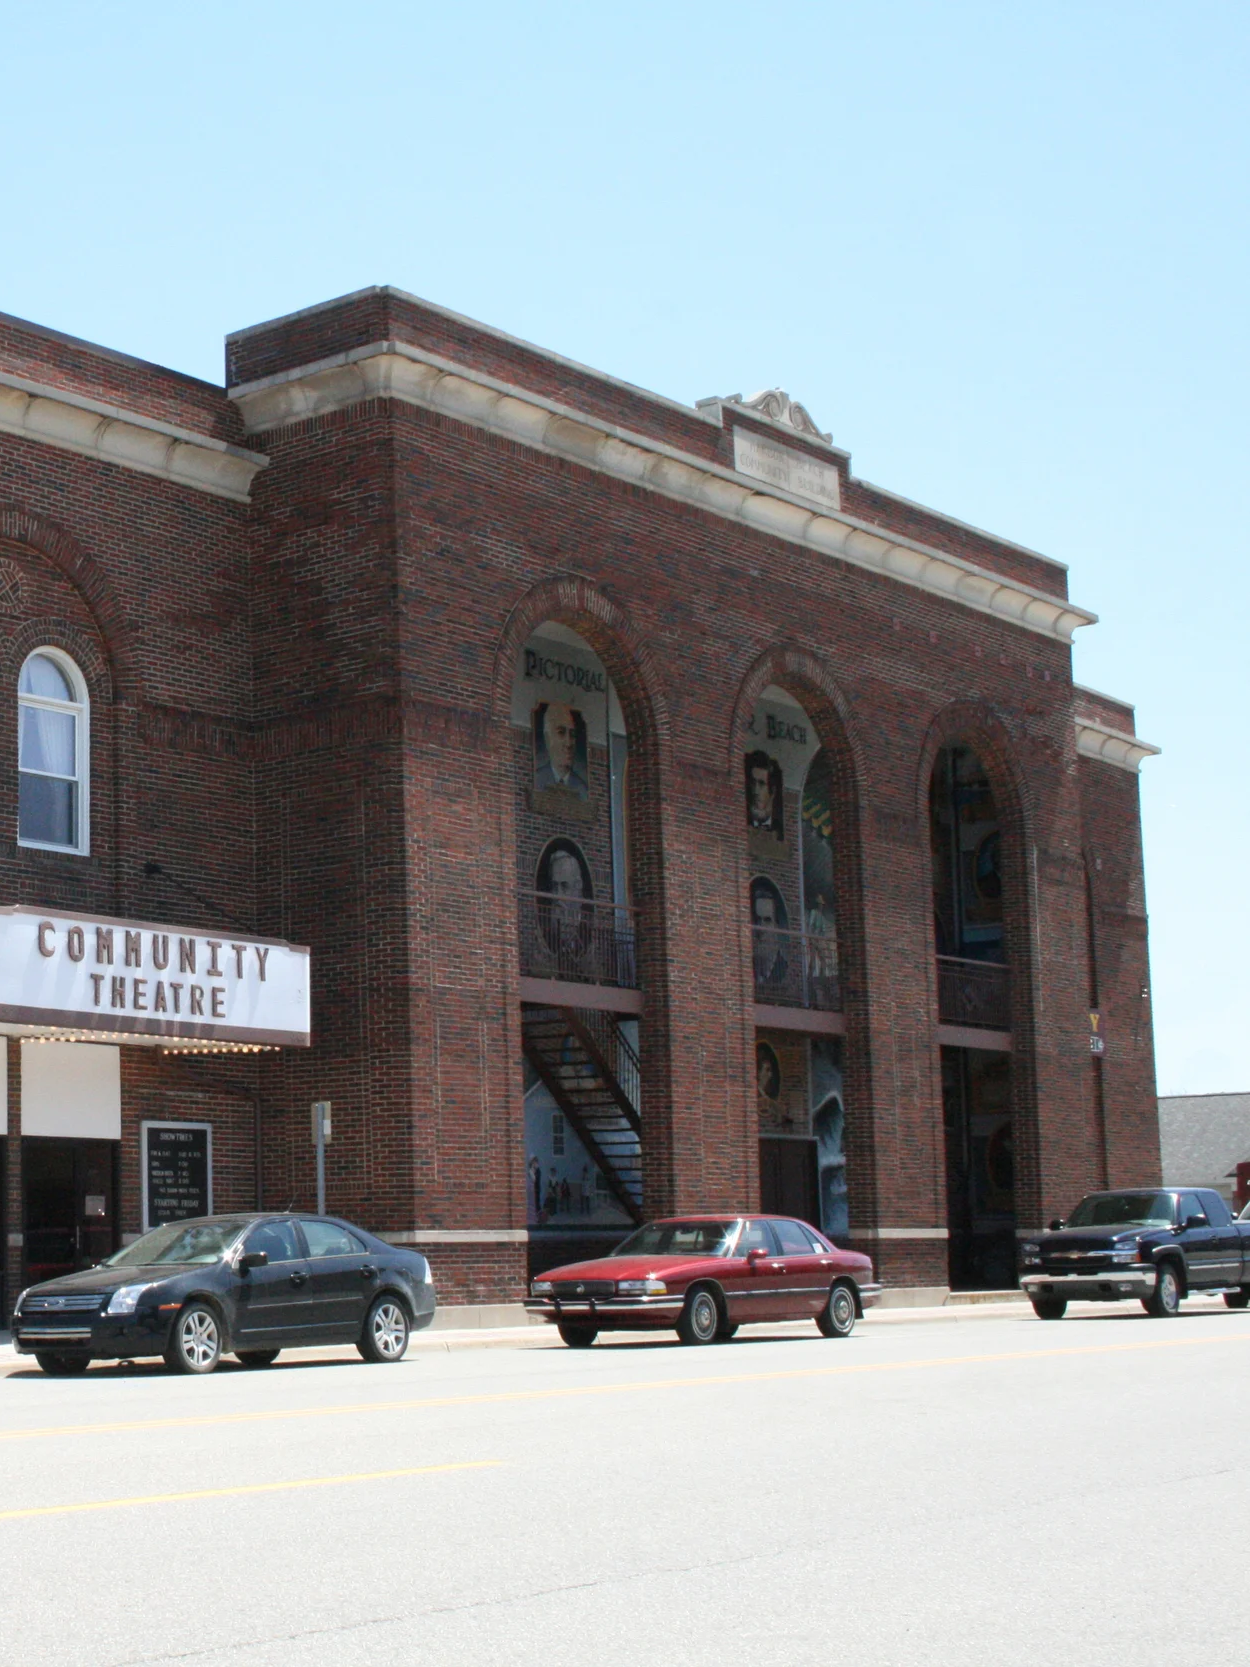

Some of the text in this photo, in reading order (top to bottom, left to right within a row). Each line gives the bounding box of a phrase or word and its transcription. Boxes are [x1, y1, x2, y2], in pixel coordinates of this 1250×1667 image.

[524, 648, 606, 692] PICTORIAL
[766, 713, 808, 745] BEACH
[38, 921, 270, 982] COMMUNITY
[90, 973, 227, 1018] THEATRE
